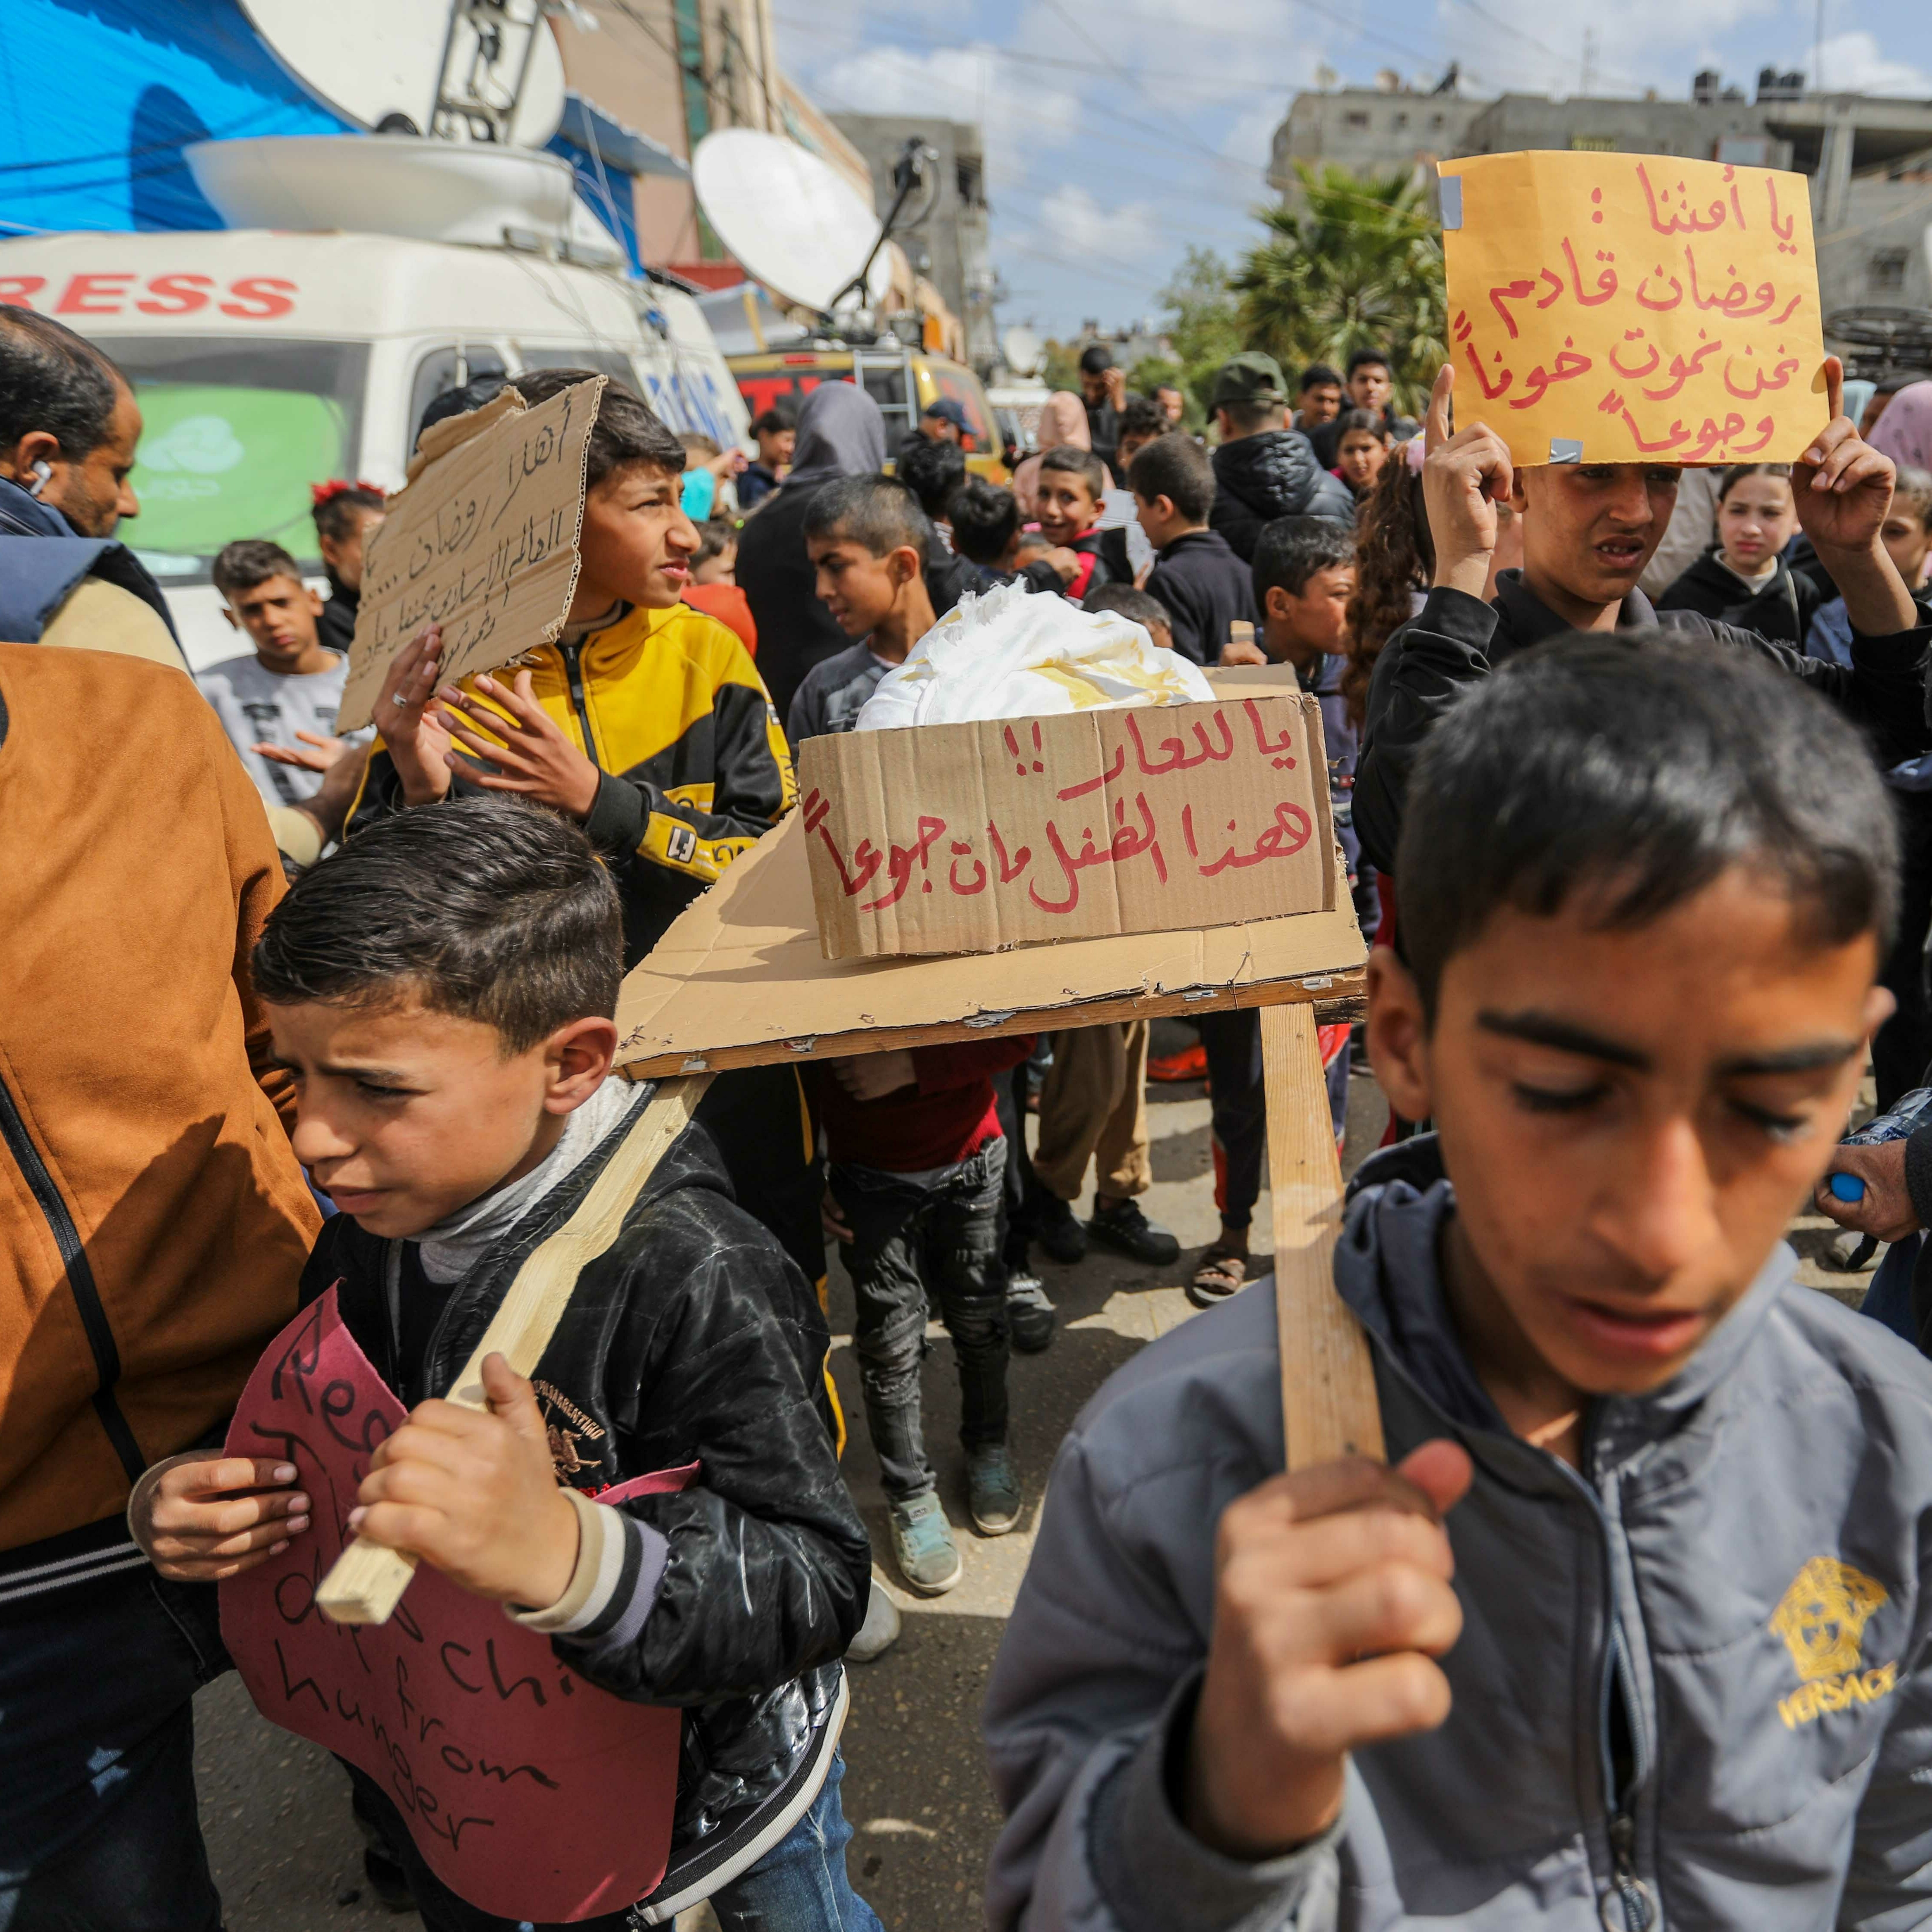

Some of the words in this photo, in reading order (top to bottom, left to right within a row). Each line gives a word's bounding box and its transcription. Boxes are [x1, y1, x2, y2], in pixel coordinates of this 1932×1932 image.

[1765, 176, 1797, 256] يا
[1489, 237, 1619, 340] قادم
[1636, 243, 1802, 325] رمضان
[1609, 328, 1722, 401] نموت
[1723, 344, 1800, 400] نحن
[1056, 708, 1234, 802] للعار
[1242, 697, 1297, 770] يا
[949, 820, 1032, 896] مات
[1028, 792, 1169, 914] الطفل
[275, 1638, 496, 1852] hunger
[395, 1655, 560, 1790] from
